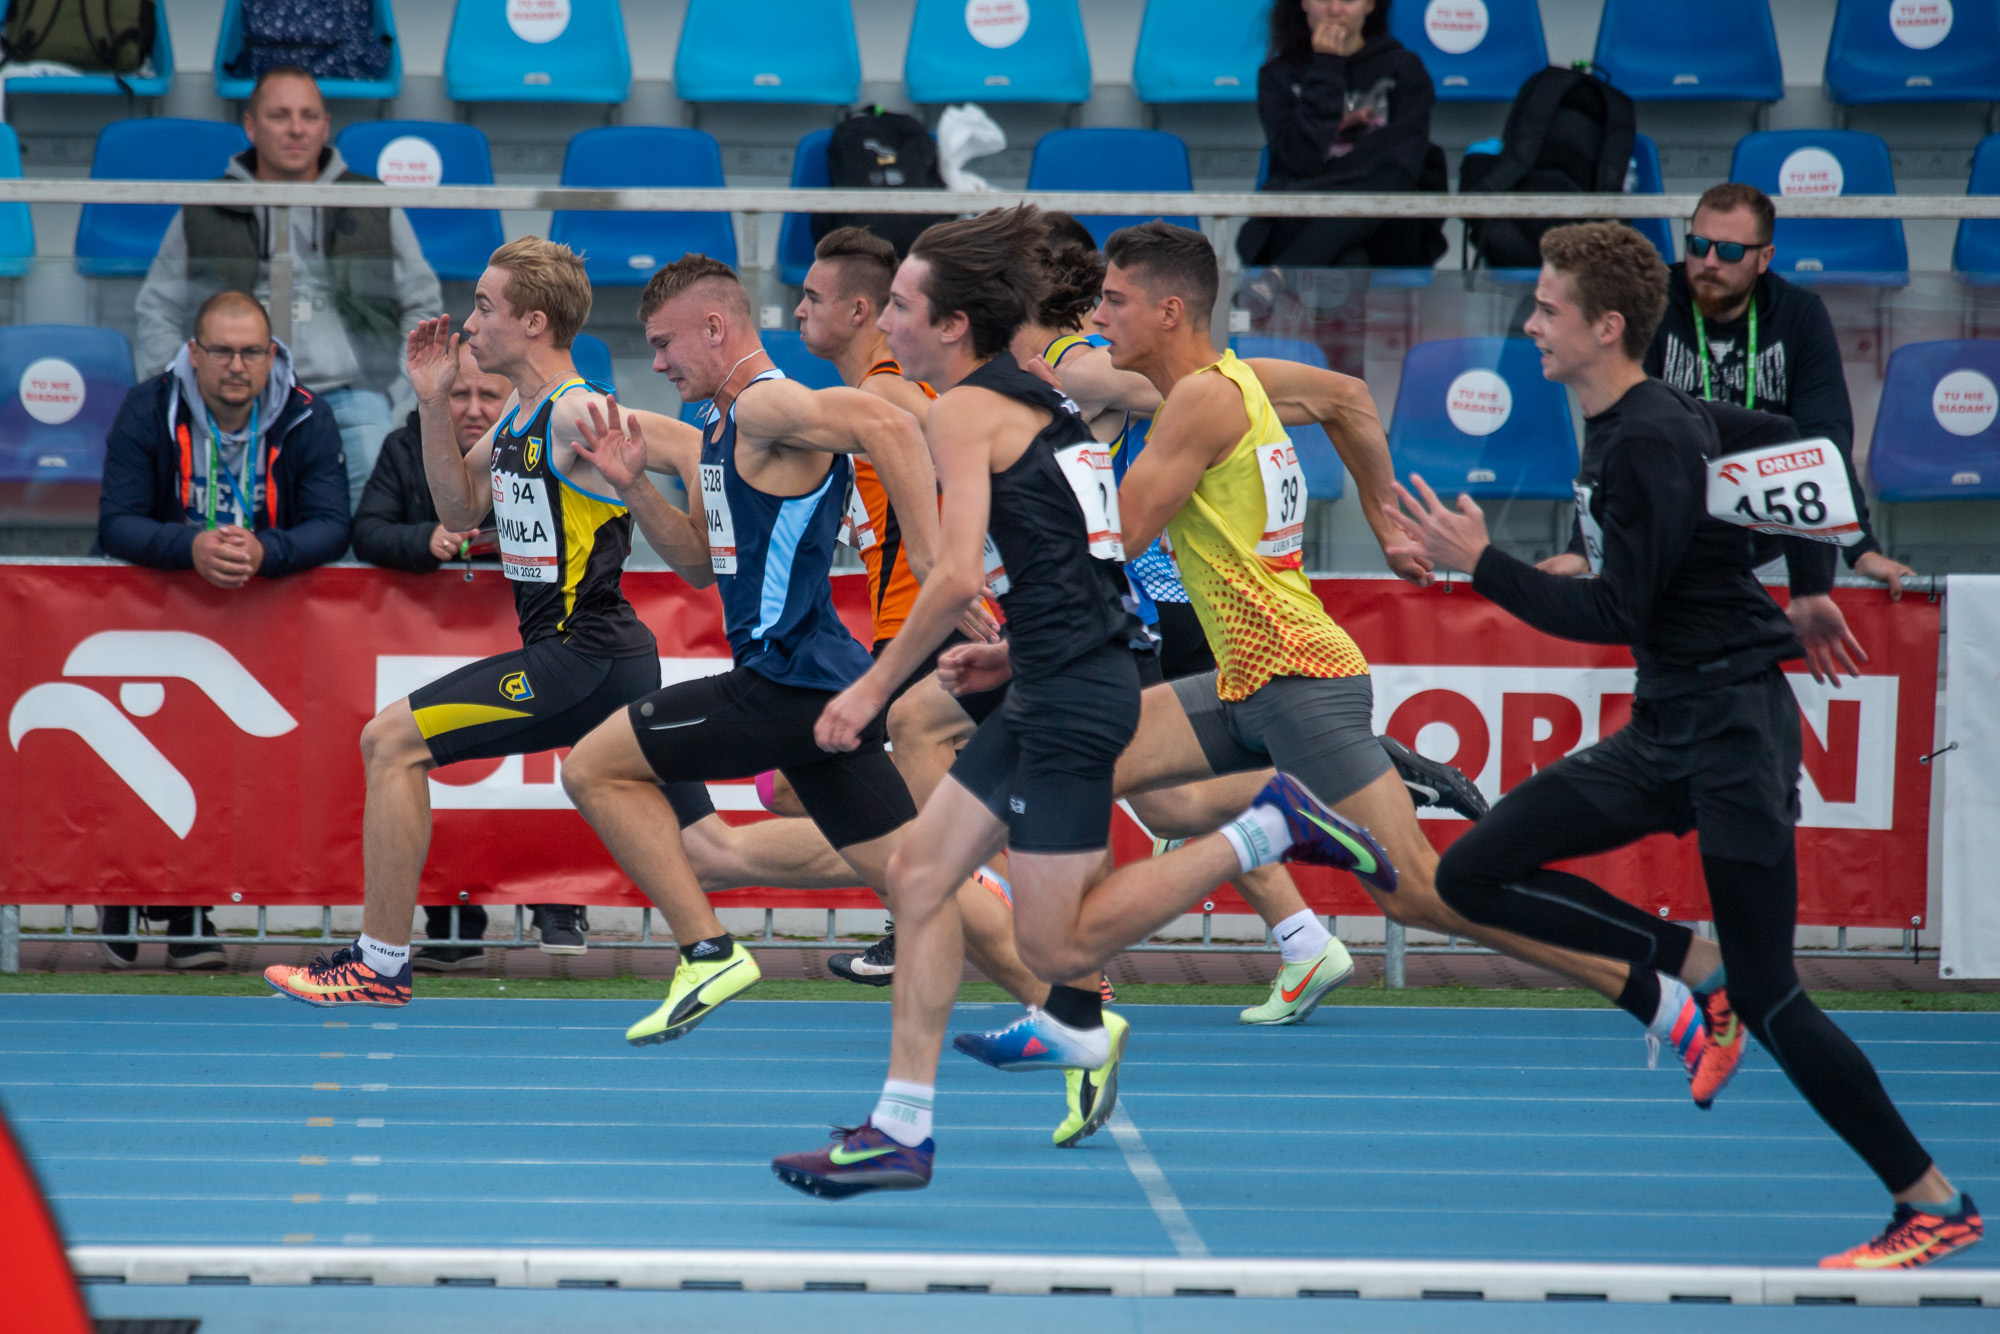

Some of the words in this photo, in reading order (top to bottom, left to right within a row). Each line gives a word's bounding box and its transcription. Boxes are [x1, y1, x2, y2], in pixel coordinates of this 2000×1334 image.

[1459, 388, 1475, 399] TU
[1477, 391, 1498, 402] NIE
[1943, 391, 1961, 401] TU
[1963, 391, 1984, 401] NIE
[1938, 404, 1993, 414] SIADAMY
[1760, 450, 1821, 475] ORLEN
[703, 468, 722, 493] 528
[512, 482, 534, 504] 94
[1281, 475, 1298, 523] 39
[1733, 481, 1828, 526] 158
[520, 566, 542, 578] 2022
[370, 944, 406, 958] adidas
